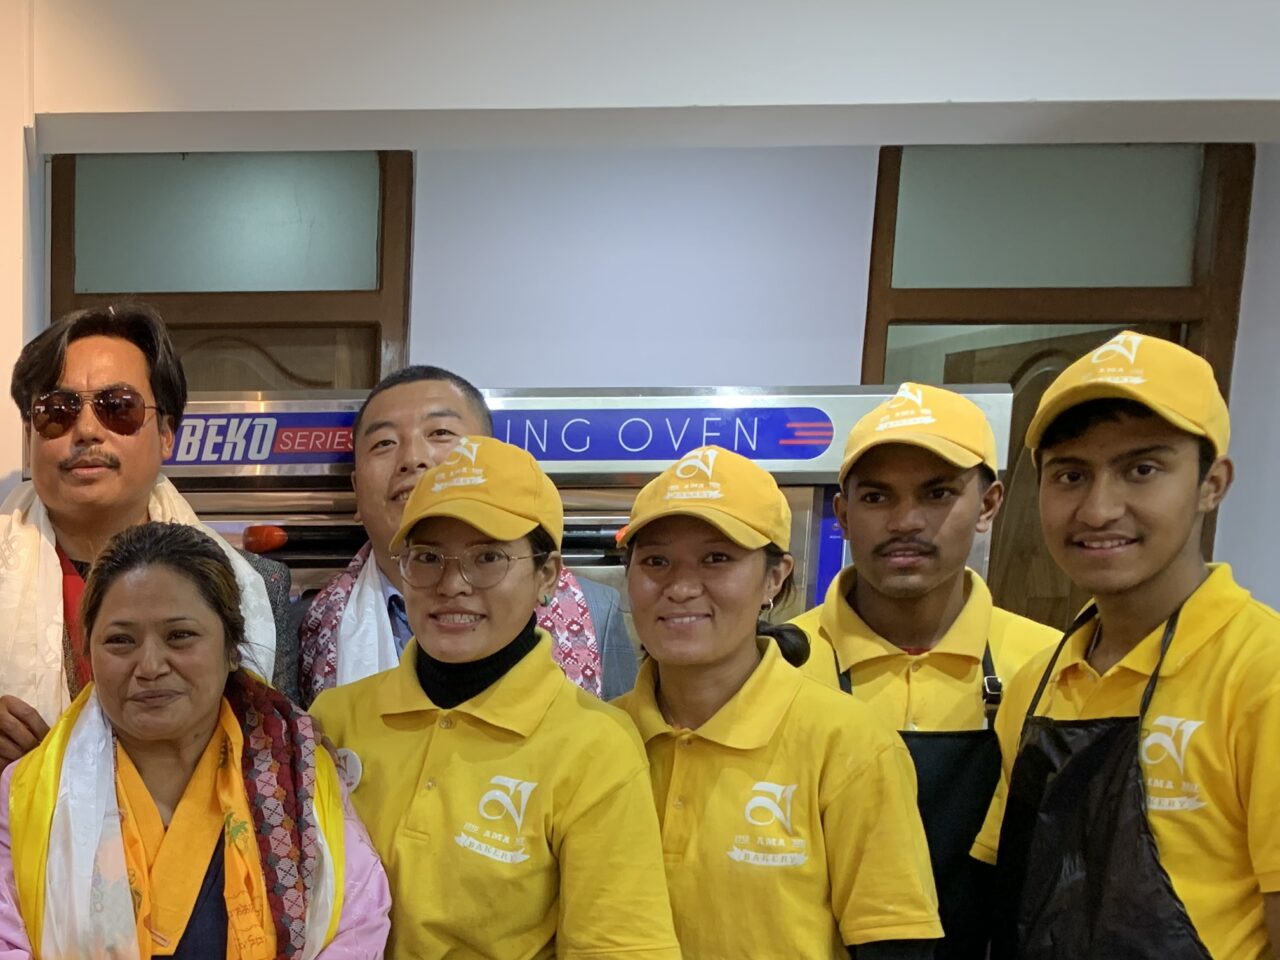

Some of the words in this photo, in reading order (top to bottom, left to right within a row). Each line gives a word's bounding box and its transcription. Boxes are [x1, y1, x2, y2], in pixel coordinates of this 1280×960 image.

[176, 417, 277, 462] BEKO
[506, 417, 591, 452] ING
[618, 417, 758, 452] OVEN
